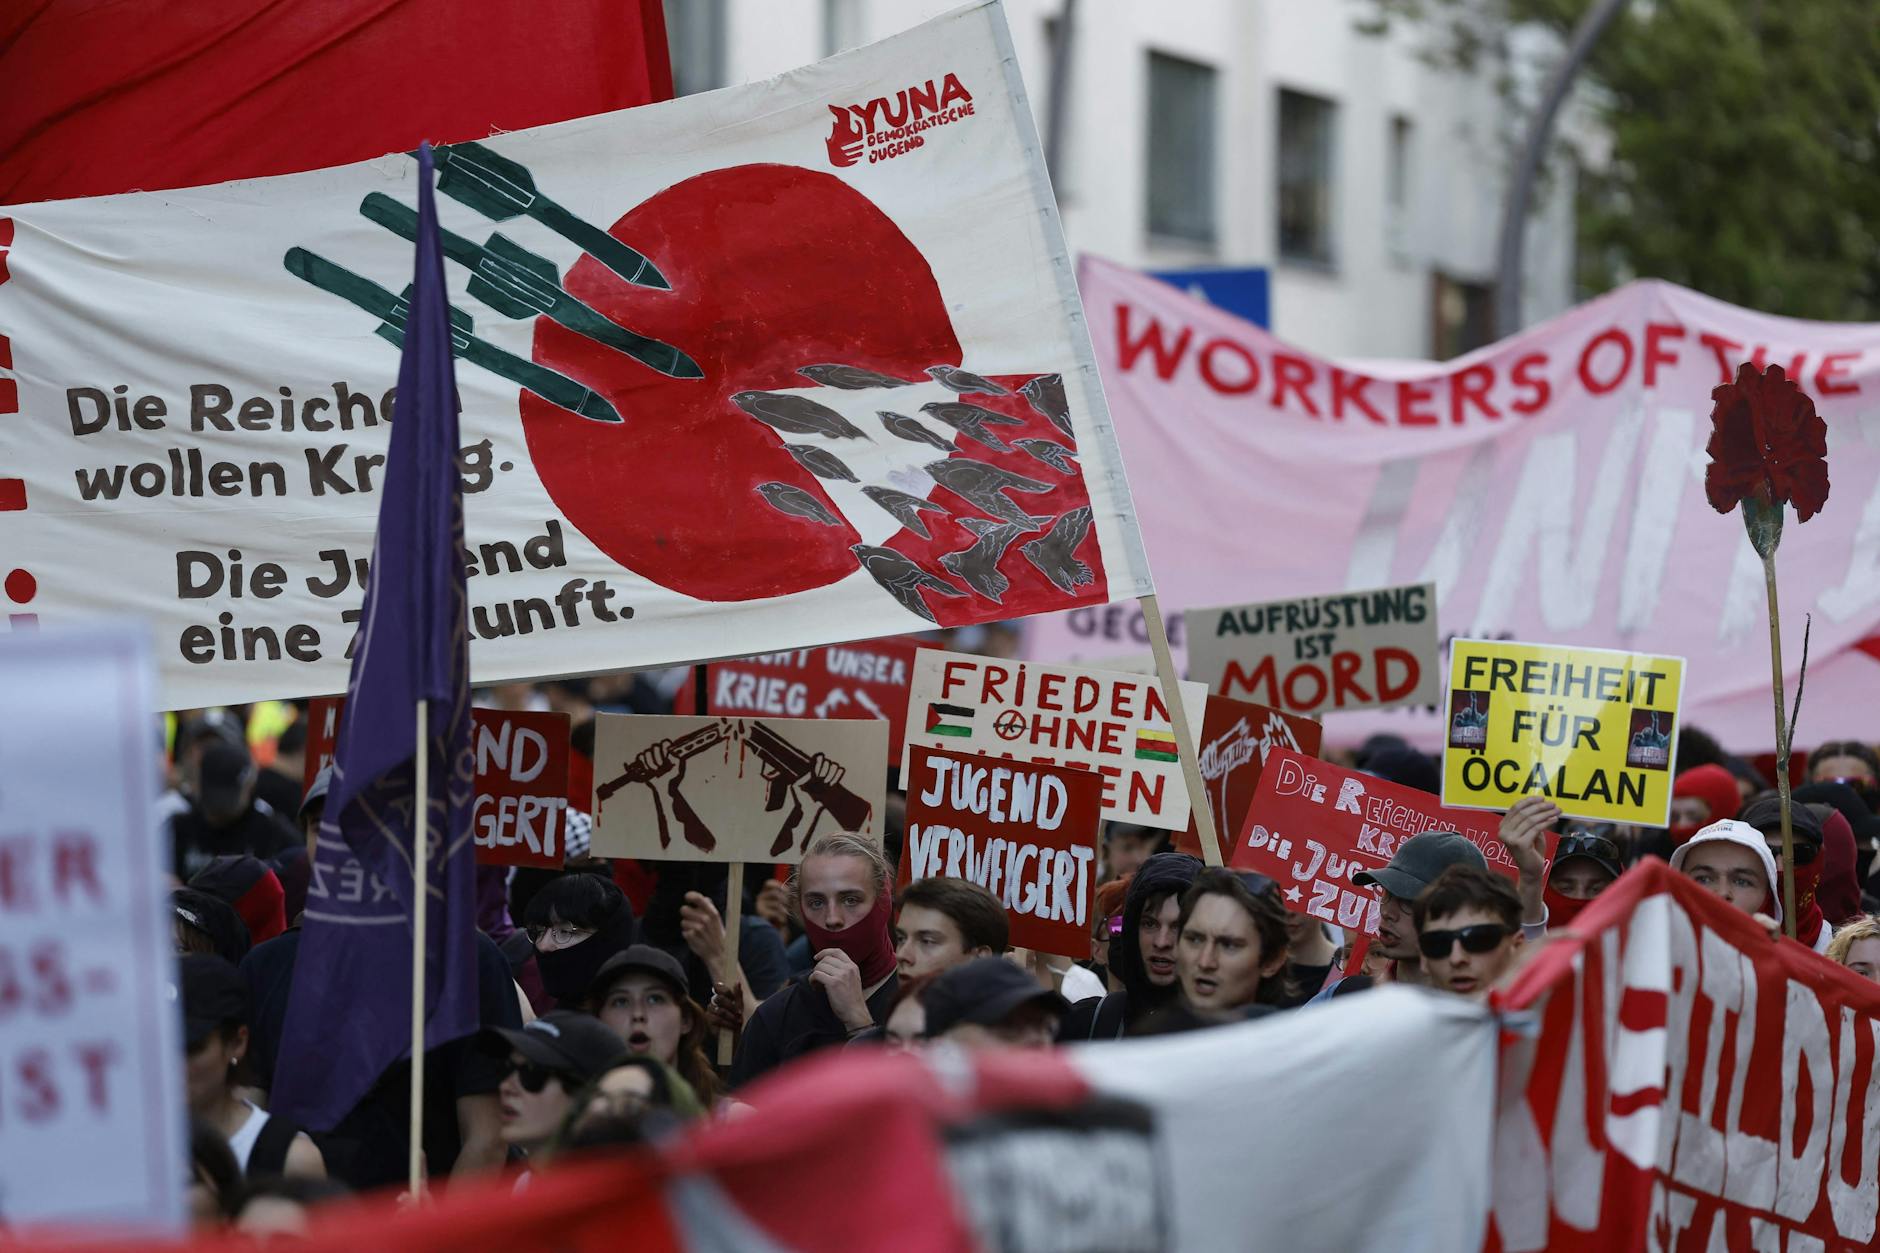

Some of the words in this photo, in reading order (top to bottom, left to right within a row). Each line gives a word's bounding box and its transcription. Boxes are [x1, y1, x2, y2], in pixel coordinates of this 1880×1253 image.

[848, 72, 973, 135] YUNA
[867, 103, 975, 147] DEMOKRATISCHE
[869, 135, 925, 164] JUGEND
[1114, 303, 1552, 427] WORKERS
[1578, 323, 1686, 395] OF
[67, 384, 167, 436] Die
[190, 382, 463, 432] Reiche
[76, 448, 287, 500] wollen
[305, 439, 514, 497] Krg.
[177, 549, 288, 599] Die
[1215, 585, 1428, 637] AUFRÜSTUNG
[180, 612, 322, 664] eine
[1294, 633, 1337, 660] IST
[714, 668, 808, 716] KRIEG
[825, 647, 907, 686] UNSER
[1219, 646, 1421, 713] MORD
[1463, 656, 1666, 706] FREIHEIT
[1512, 705, 1601, 751] FÜR
[920, 755, 1068, 831] JUGEND
[1462, 749, 1647, 808] ÖCALAN
[909, 823, 1095, 928] VERWEIGERT
